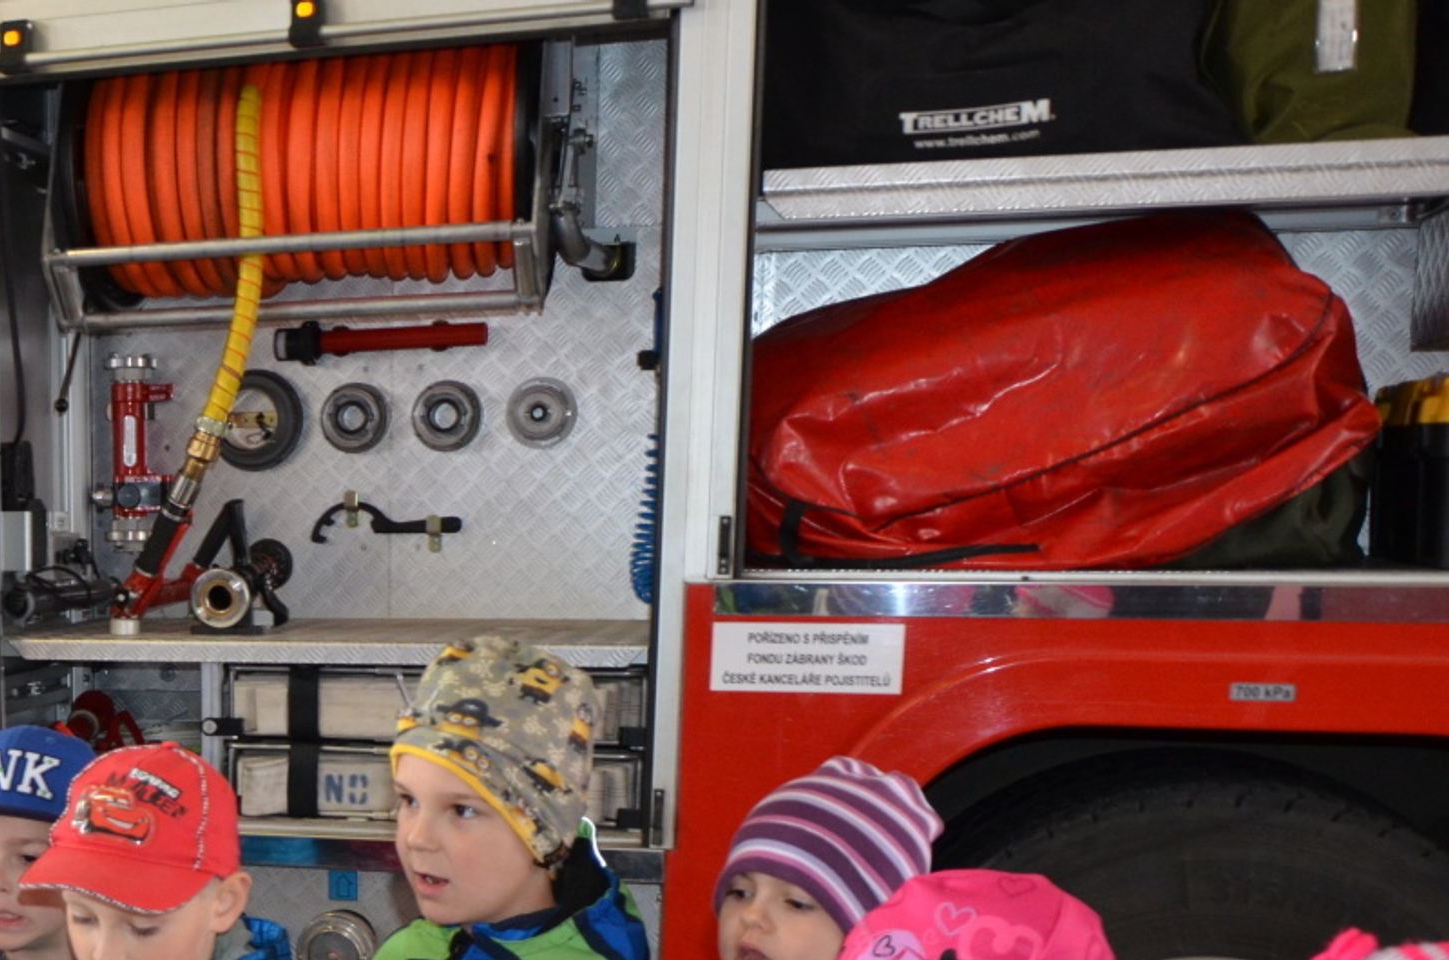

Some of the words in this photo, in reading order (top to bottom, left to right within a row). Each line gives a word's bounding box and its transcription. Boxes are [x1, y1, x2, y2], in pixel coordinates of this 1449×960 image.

[899, 98, 1052, 135] TRELLCHEM
[914, 129, 1040, 149] www.trellchem.com
[803, 633, 810, 644] S
[747, 654, 783, 665] FONDU
[785, 652, 834, 666] ZÁBRANY
[837, 652, 867, 666] ŠKOD
[722, 671, 757, 685] ČESKÉ
[759, 672, 821, 686] KANCELÁŘE
[825, 673, 891, 687] POJISTITELŮ
